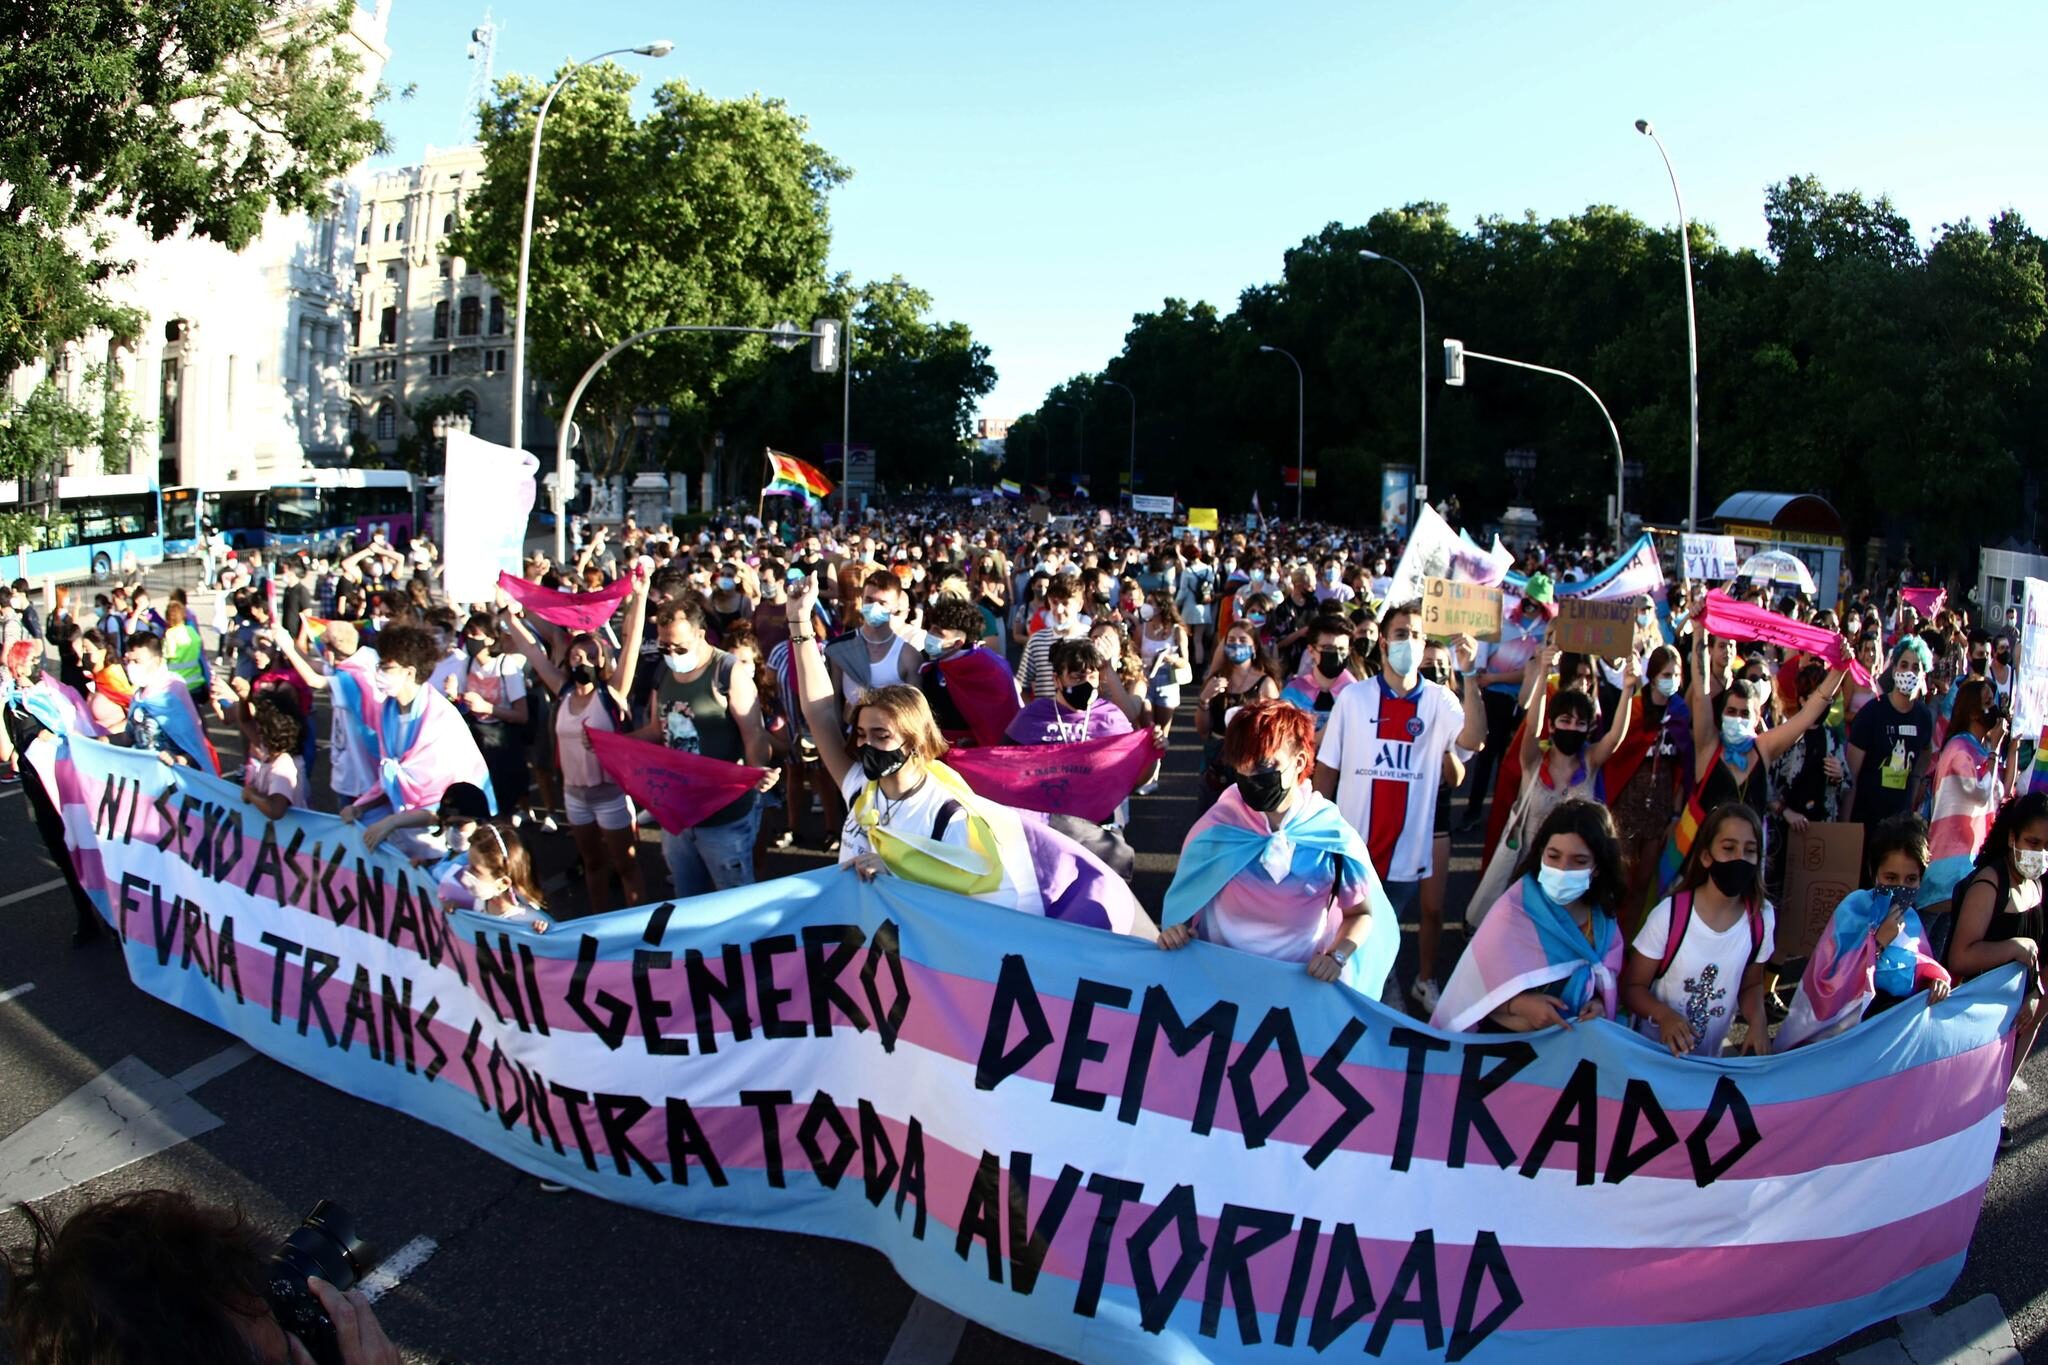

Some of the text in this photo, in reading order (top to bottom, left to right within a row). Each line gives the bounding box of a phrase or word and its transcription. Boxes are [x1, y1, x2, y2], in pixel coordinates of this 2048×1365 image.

[1427, 579, 1444, 597] LO
[1445, 608, 1496, 628] NATURAL
[1808, 846, 1822, 865] NO
[96, 773, 140, 844] NI
[156, 783, 242, 883] SEXO
[474, 930, 550, 1036] NI
[565, 902, 911, 1055] GÉNERO
[975, 954, 1762, 1188] DEMOSTRADO
[260, 931, 448, 1082] TRANS
[463, 1018, 729, 1188] CONTRA
[740, 1089, 926, 1240] TODA
